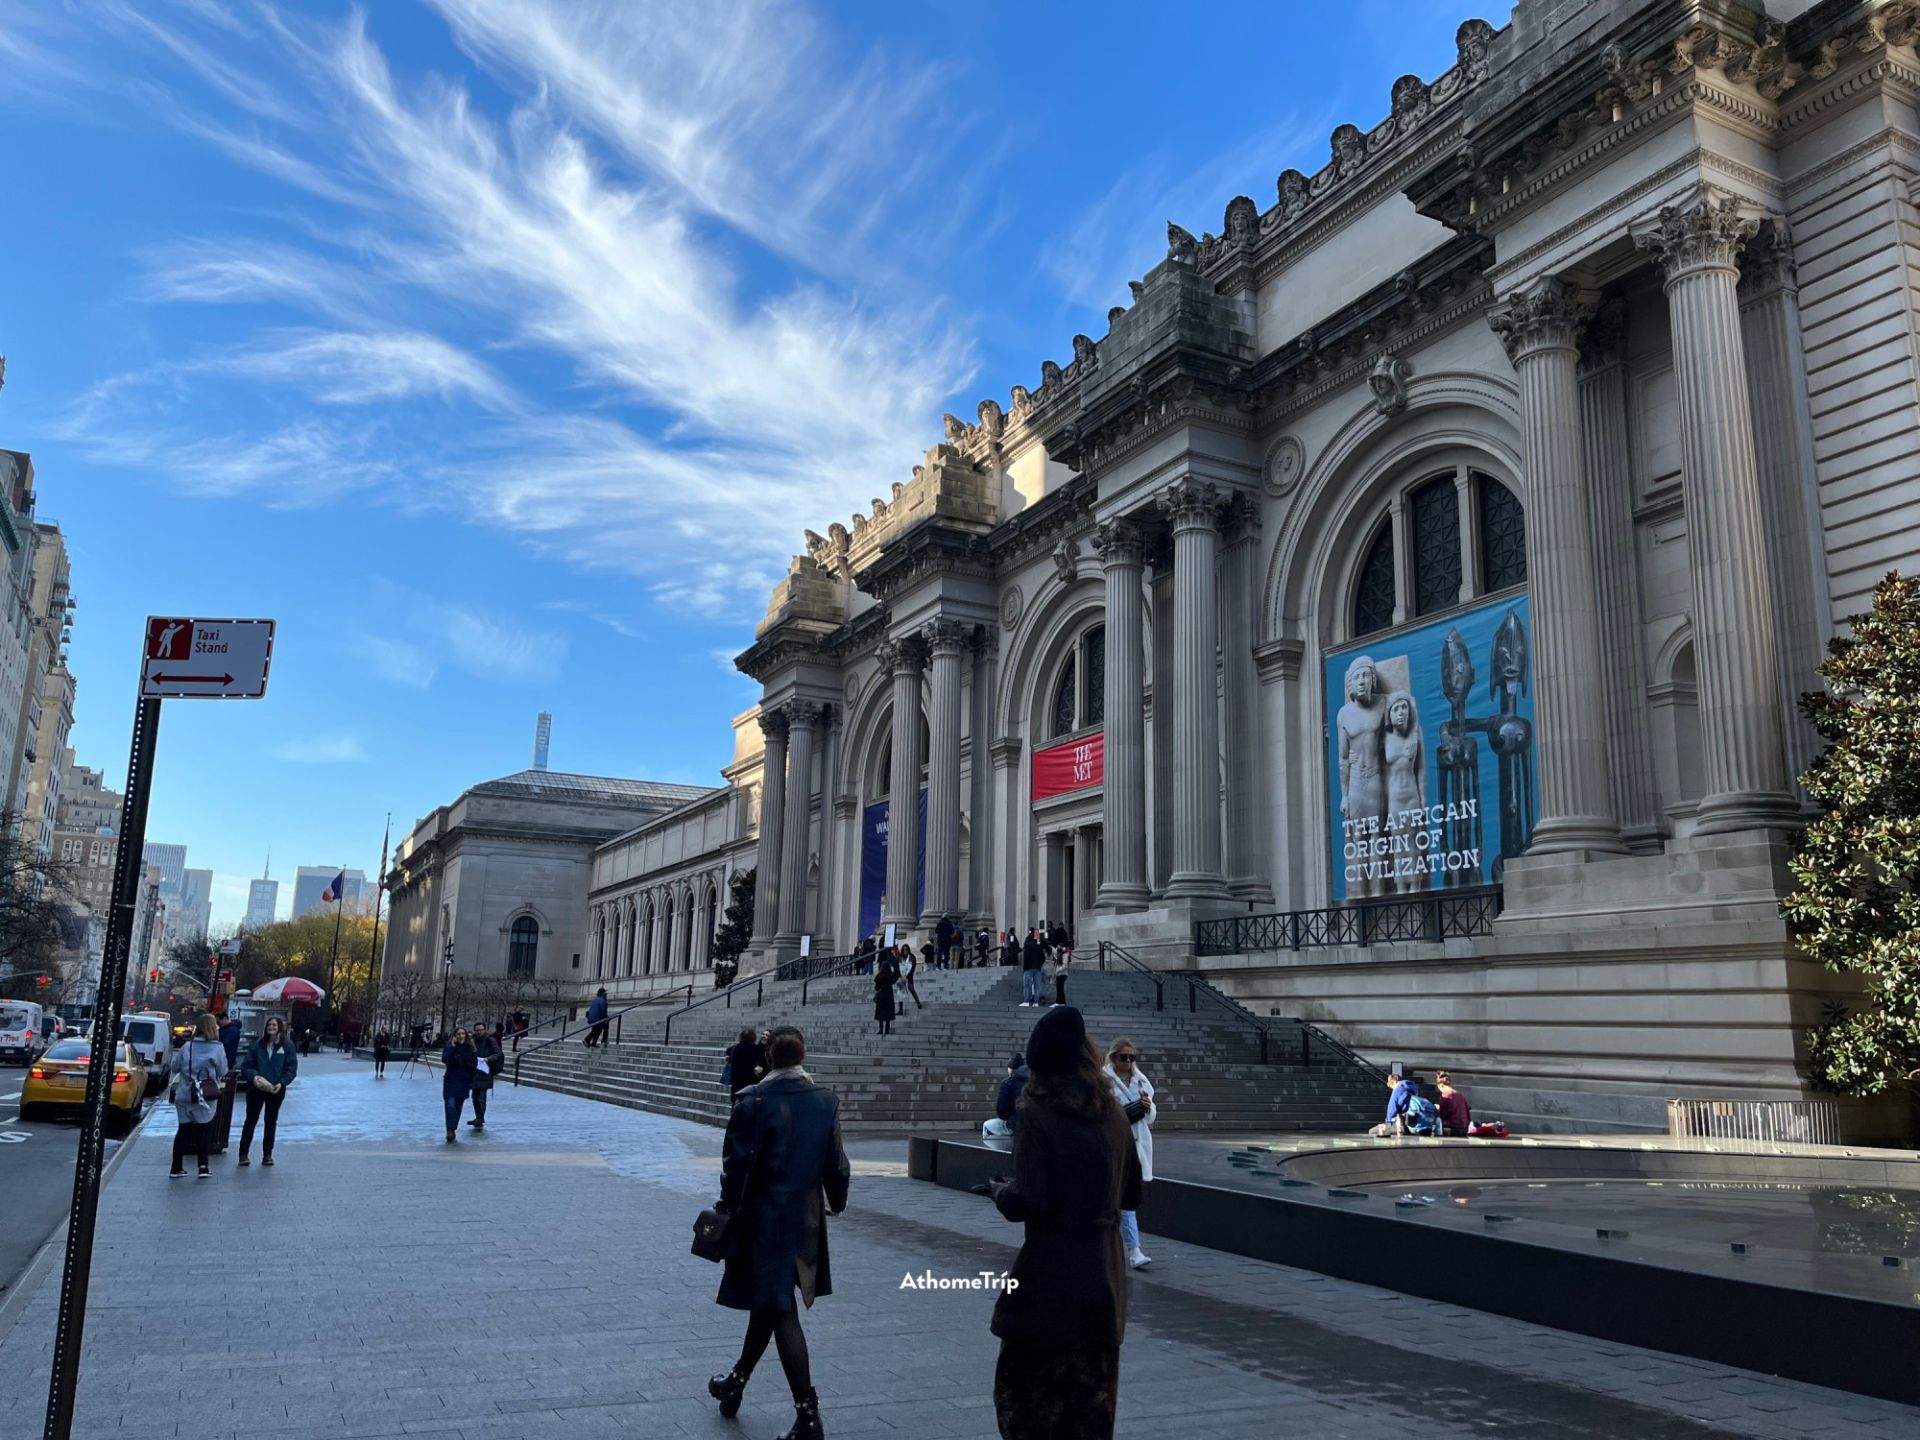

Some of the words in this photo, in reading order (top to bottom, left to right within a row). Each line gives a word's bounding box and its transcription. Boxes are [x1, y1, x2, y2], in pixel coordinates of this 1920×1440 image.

[197, 629, 220, 641] Taxi
[195, 642, 228, 653] Stand
[1074, 744, 1092, 763] THE
[1074, 762, 1092, 782] MET
[1342, 816, 1379, 837] THE
[1384, 799, 1477, 831] AFRICAN
[1343, 834, 1410, 859] ORIGIN
[1415, 829, 1443, 850] OF
[1345, 849, 1480, 881] CIVILIZATION
